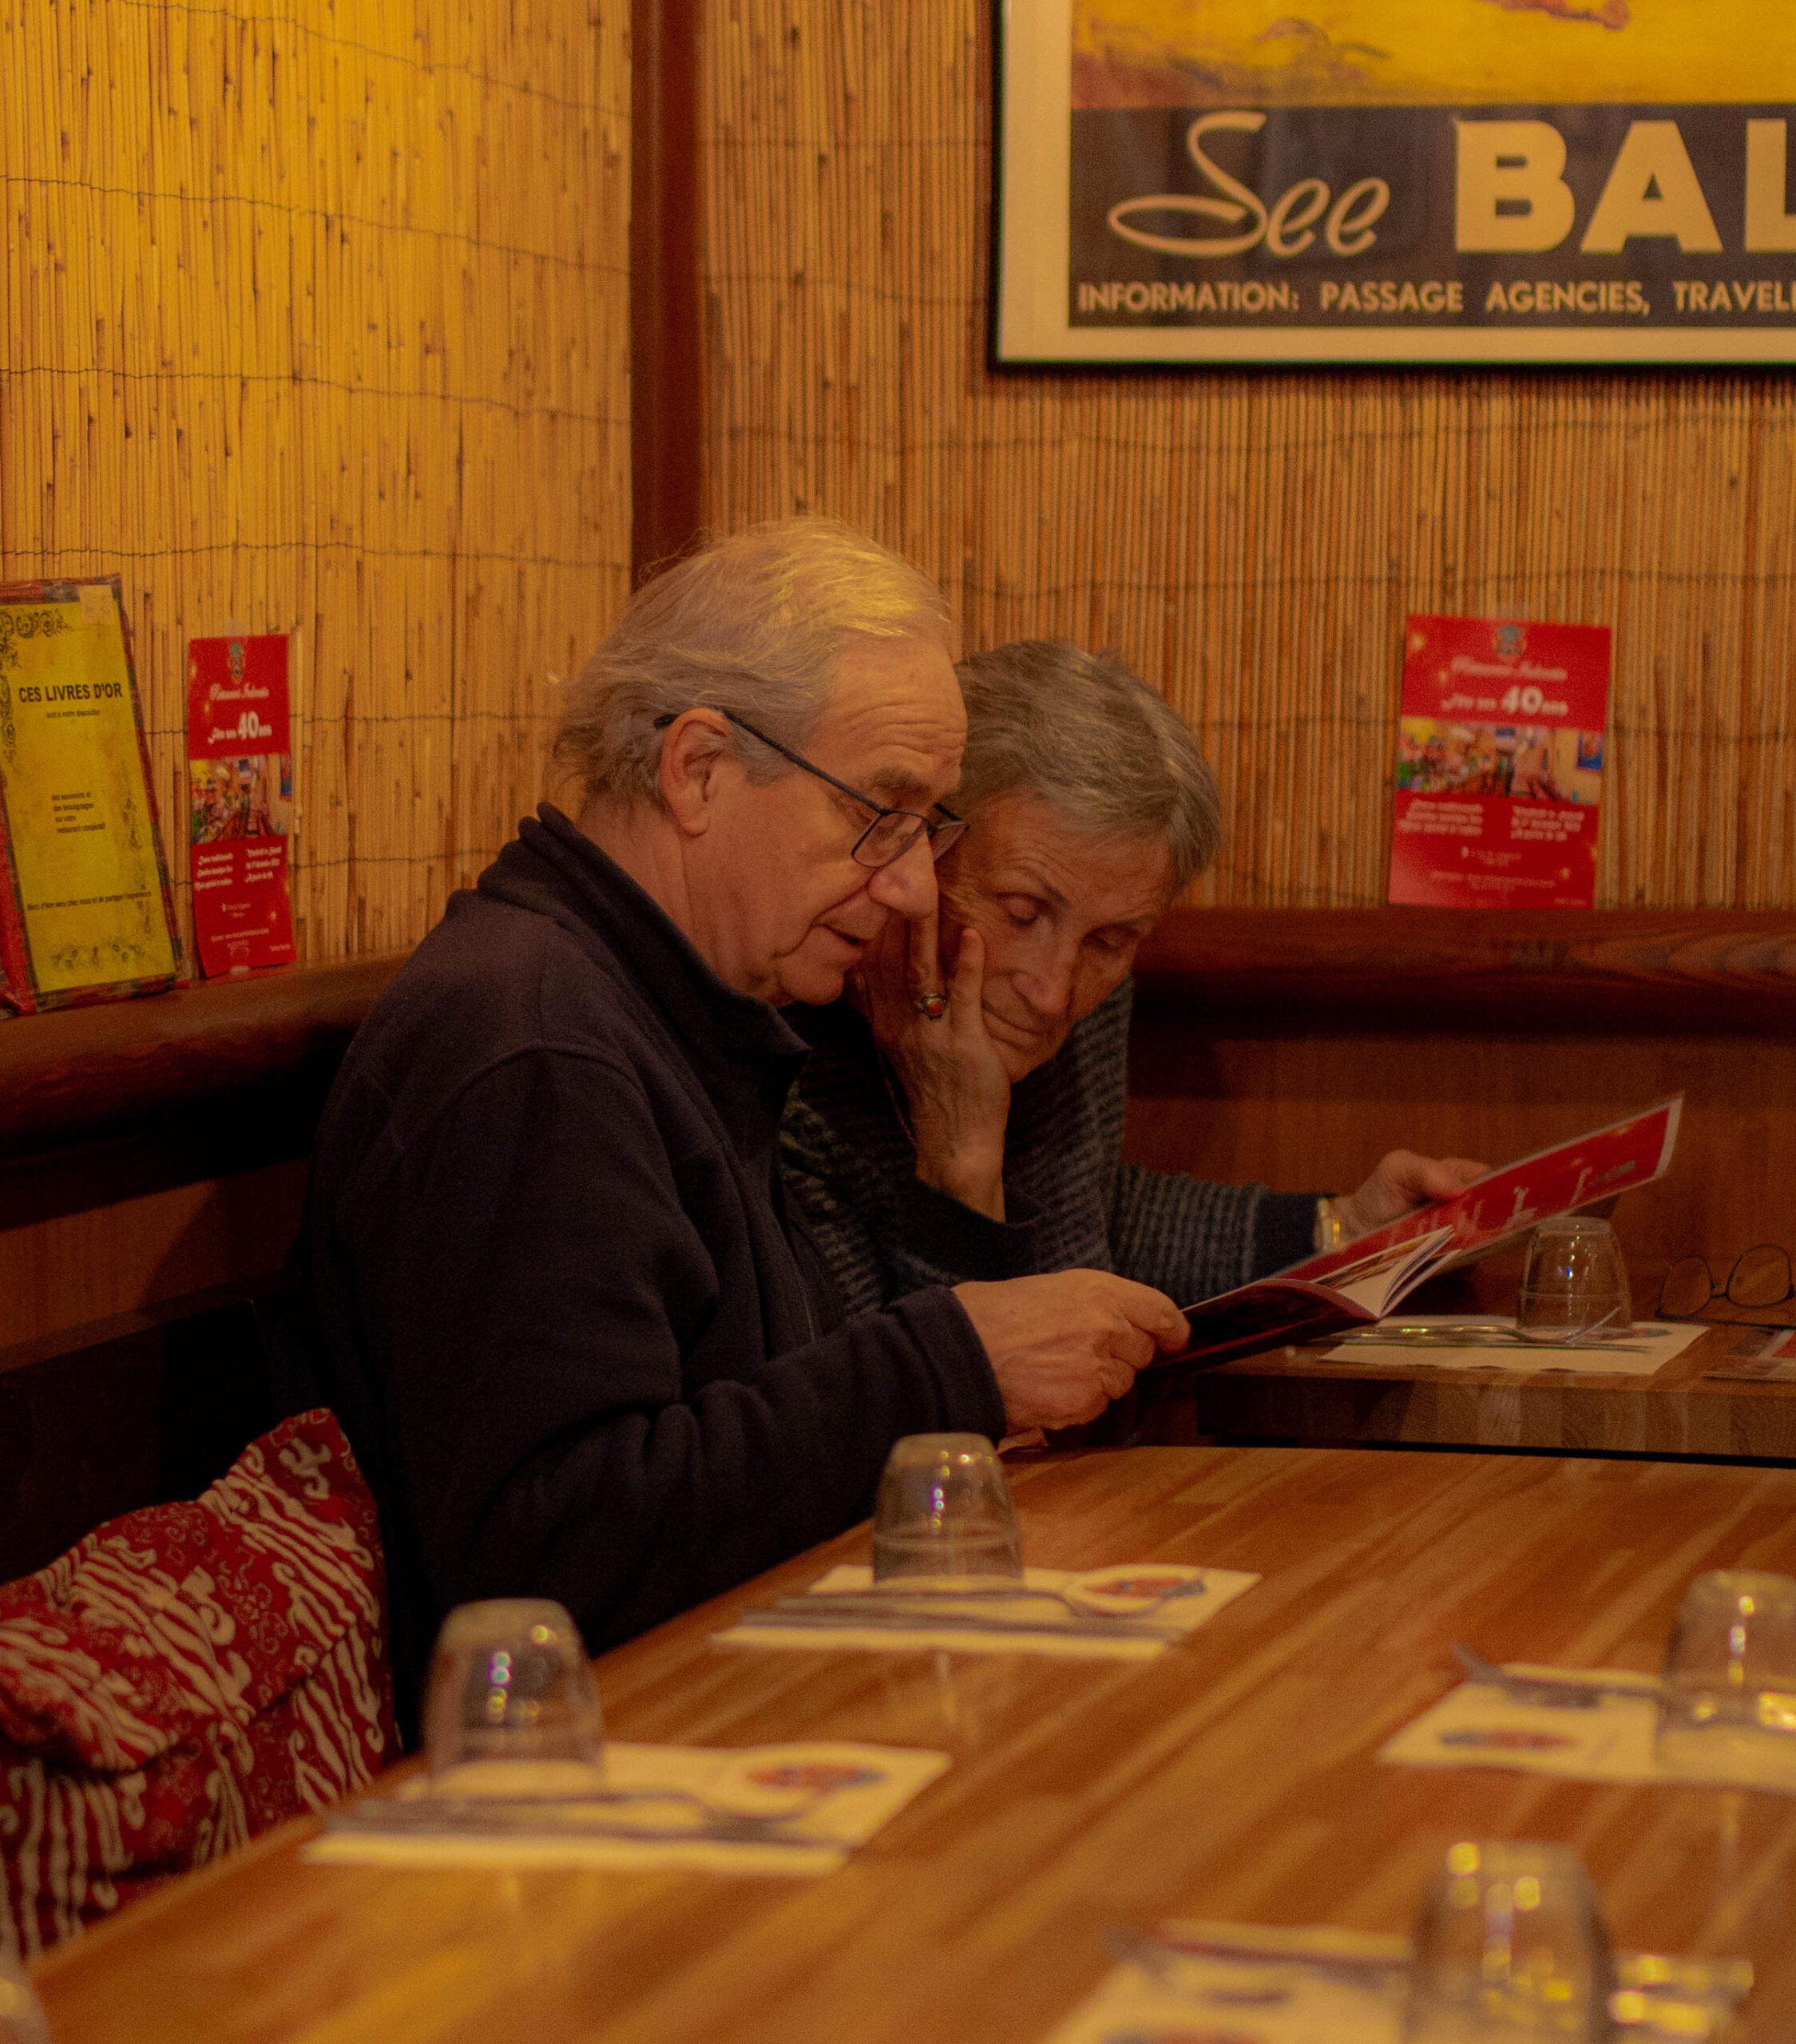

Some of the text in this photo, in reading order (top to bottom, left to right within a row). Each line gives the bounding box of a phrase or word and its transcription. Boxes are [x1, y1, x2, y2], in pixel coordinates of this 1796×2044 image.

[1108, 110, 1796, 258] See BAL
[1078, 281, 1300, 313] INFORMATION:
[1320, 280, 1463, 313] PASSAGE
[1485, 280, 1651, 317] AGENCIES,
[18, 681, 123, 703] CES LIVRES D'OR
[1500, 684, 1544, 716] 40
[237, 711, 260, 740] 40
